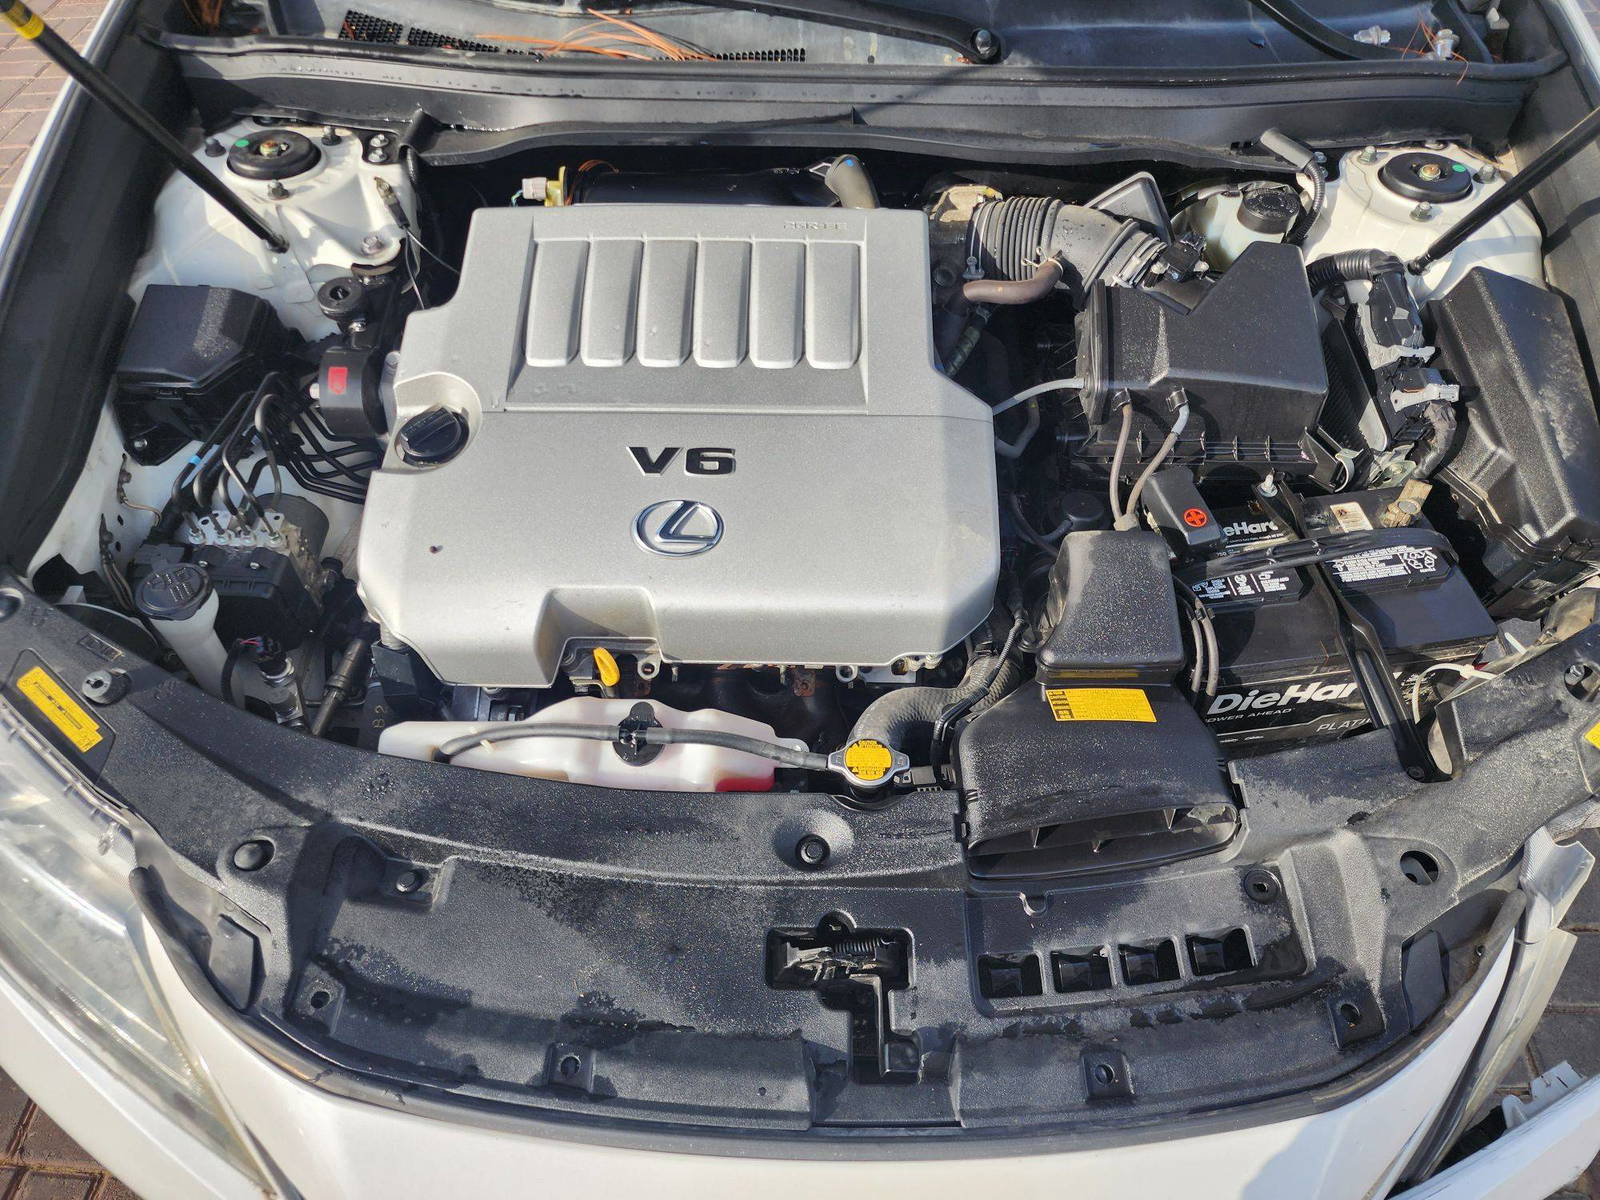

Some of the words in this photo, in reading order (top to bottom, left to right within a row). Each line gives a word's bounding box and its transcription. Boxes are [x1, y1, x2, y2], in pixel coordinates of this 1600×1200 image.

[626, 446, 736, 477] V6
[1206, 681, 1358, 715] DieHar
[1205, 714, 1244, 724] OWER
